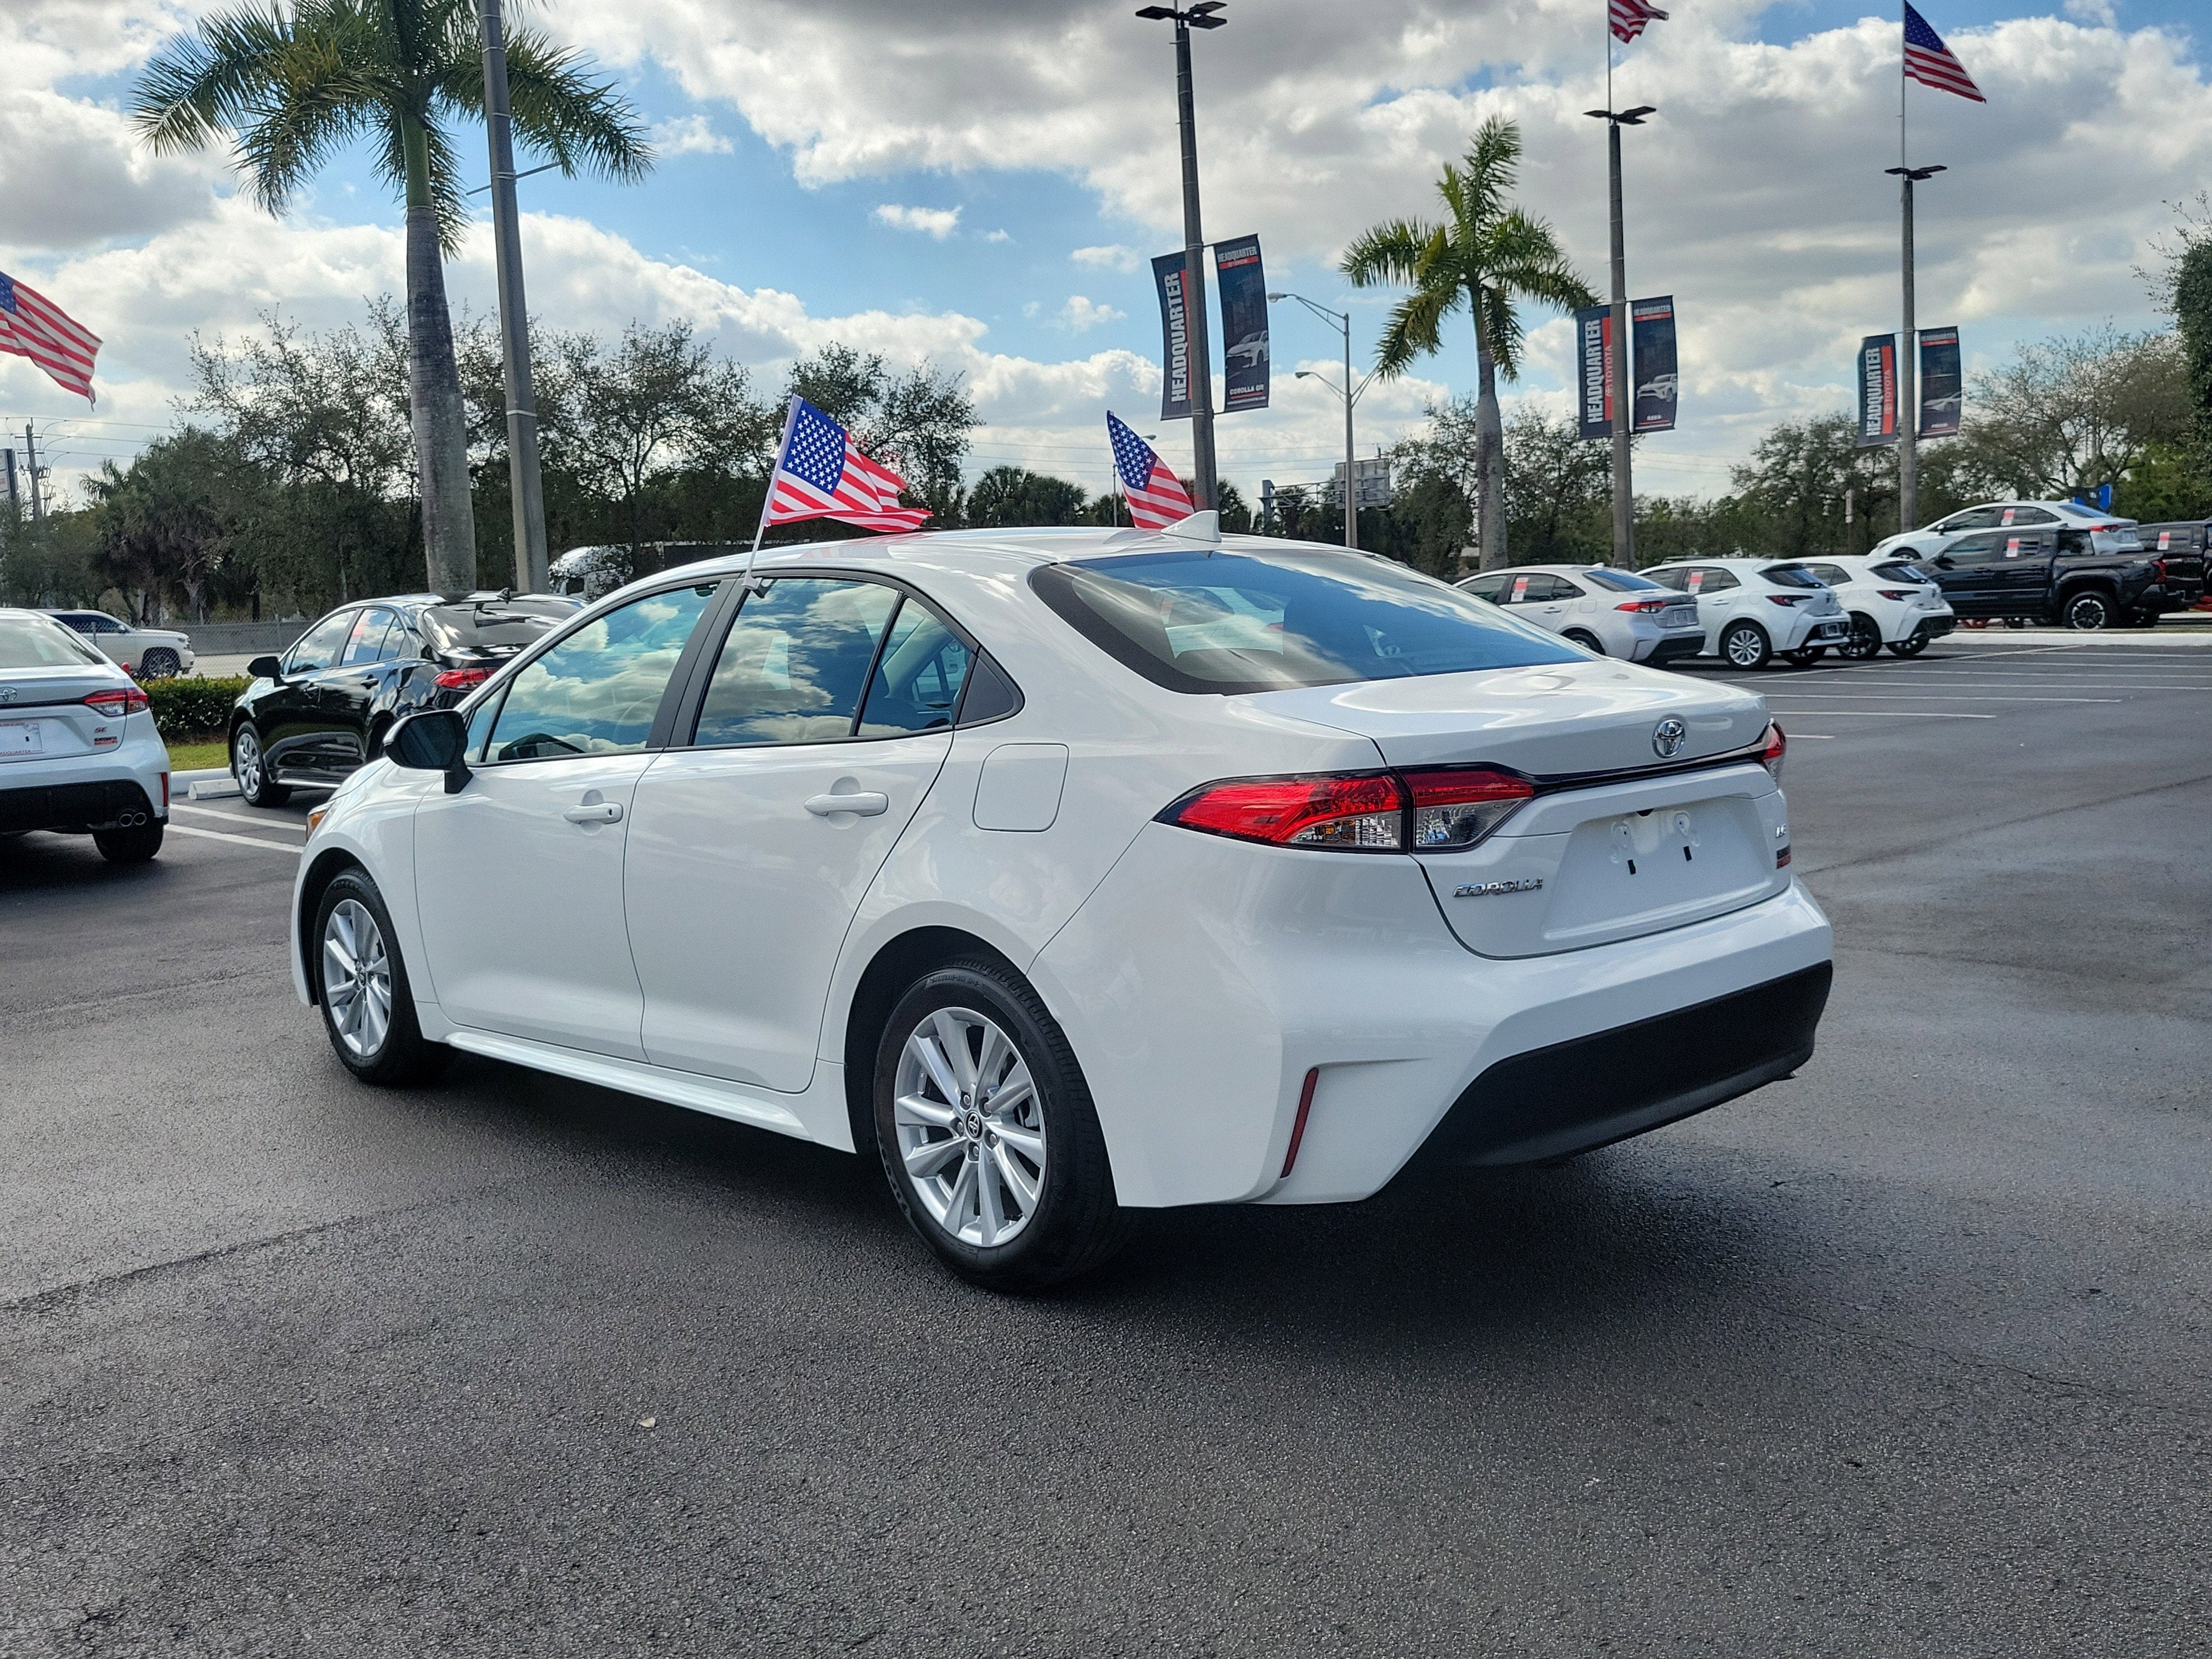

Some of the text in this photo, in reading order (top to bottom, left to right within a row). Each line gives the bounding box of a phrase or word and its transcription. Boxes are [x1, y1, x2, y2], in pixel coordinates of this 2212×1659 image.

[1164, 271, 1188, 403] HEADQUARTER
[1584, 319, 1604, 424] HEADQUARTER
[1604, 345, 1613, 383] TOYOTA
[1229, 385, 1255, 396] COROLLA
[1865, 347, 1883, 437] HEADQUARTER
[1883, 369, 1893, 403] TOYOTA
[1453, 877, 1543, 898] COROLLA
